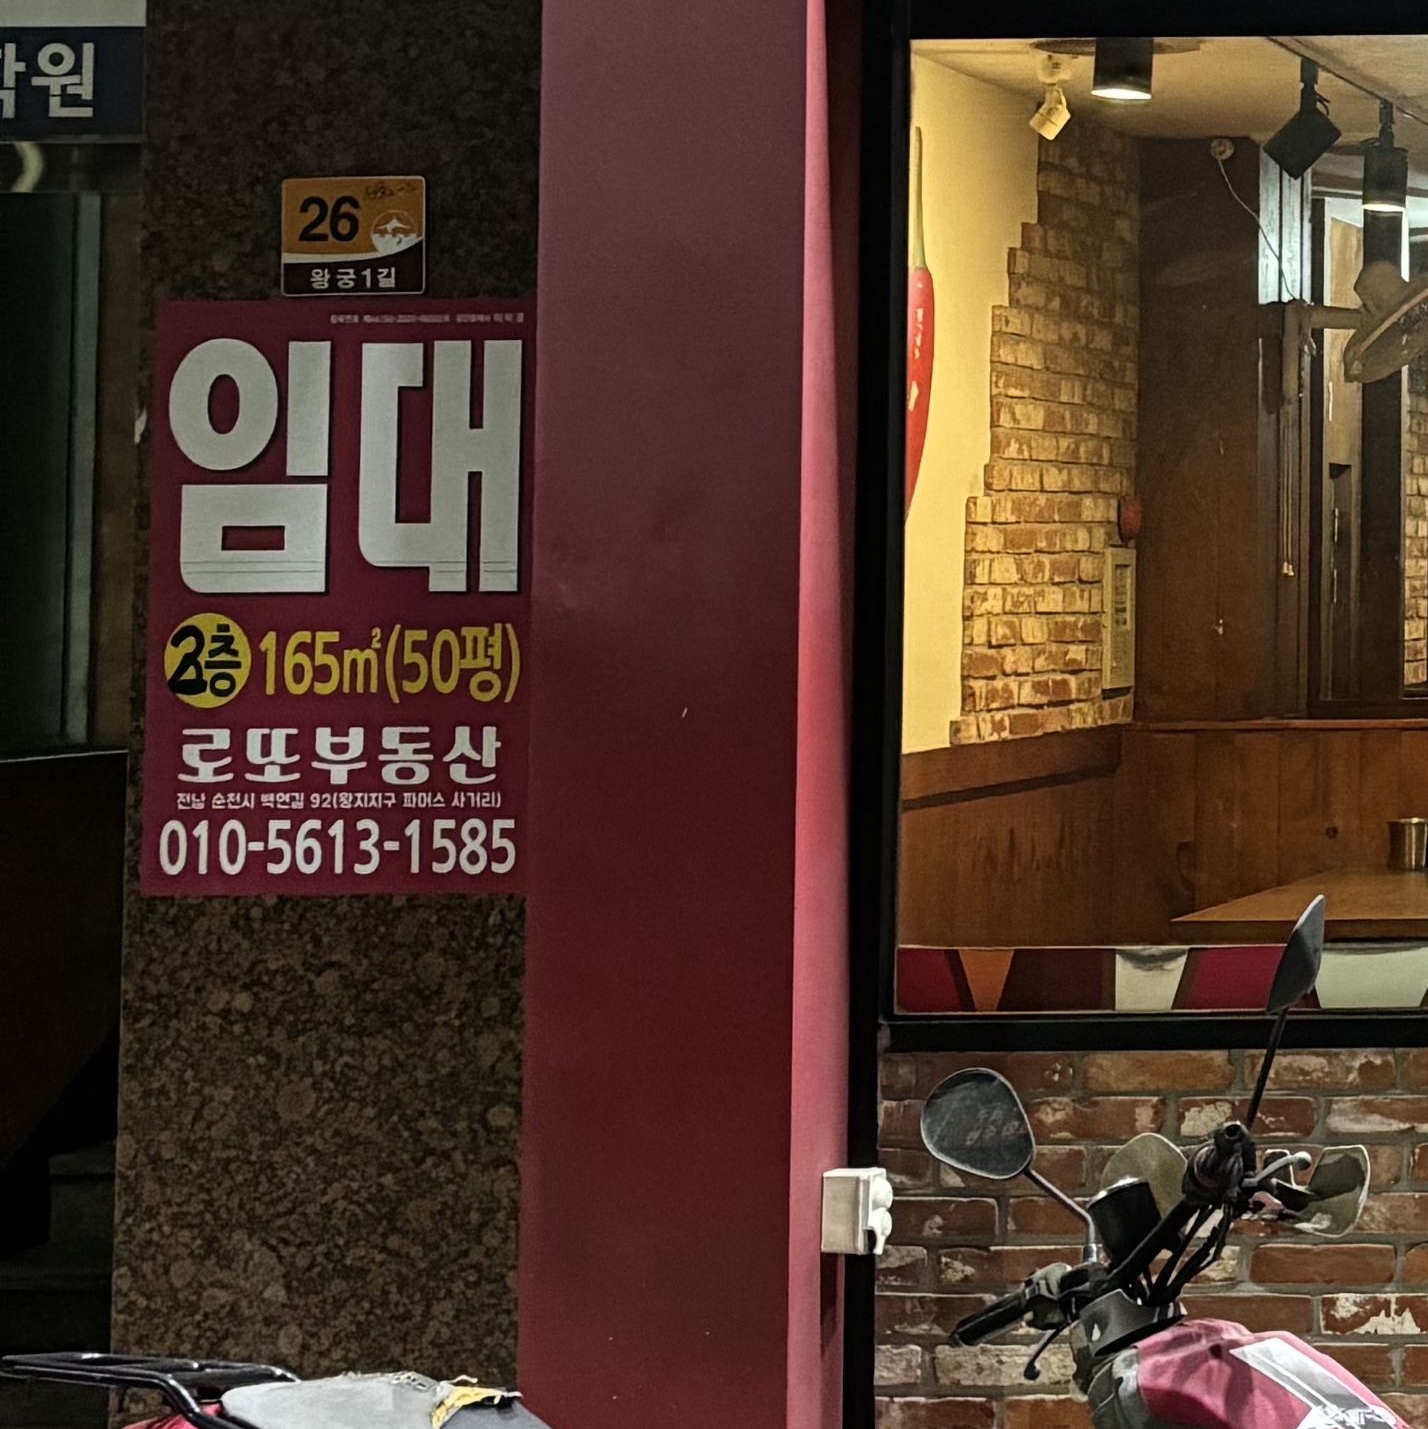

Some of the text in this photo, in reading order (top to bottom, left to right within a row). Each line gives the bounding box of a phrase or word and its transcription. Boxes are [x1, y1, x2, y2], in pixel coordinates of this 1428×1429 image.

[299, 196, 361, 242] 26
[169, 338, 523, 593] 임대
[177, 726, 502, 785] 로또부동산
[176, 792, 206, 810] 전남
[211, 792, 255, 810] 순천시
[402, 791, 446, 809] 파머스
[451, 791, 502, 809] 사거리)
[160, 819, 516, 875] 010-5613-1585
